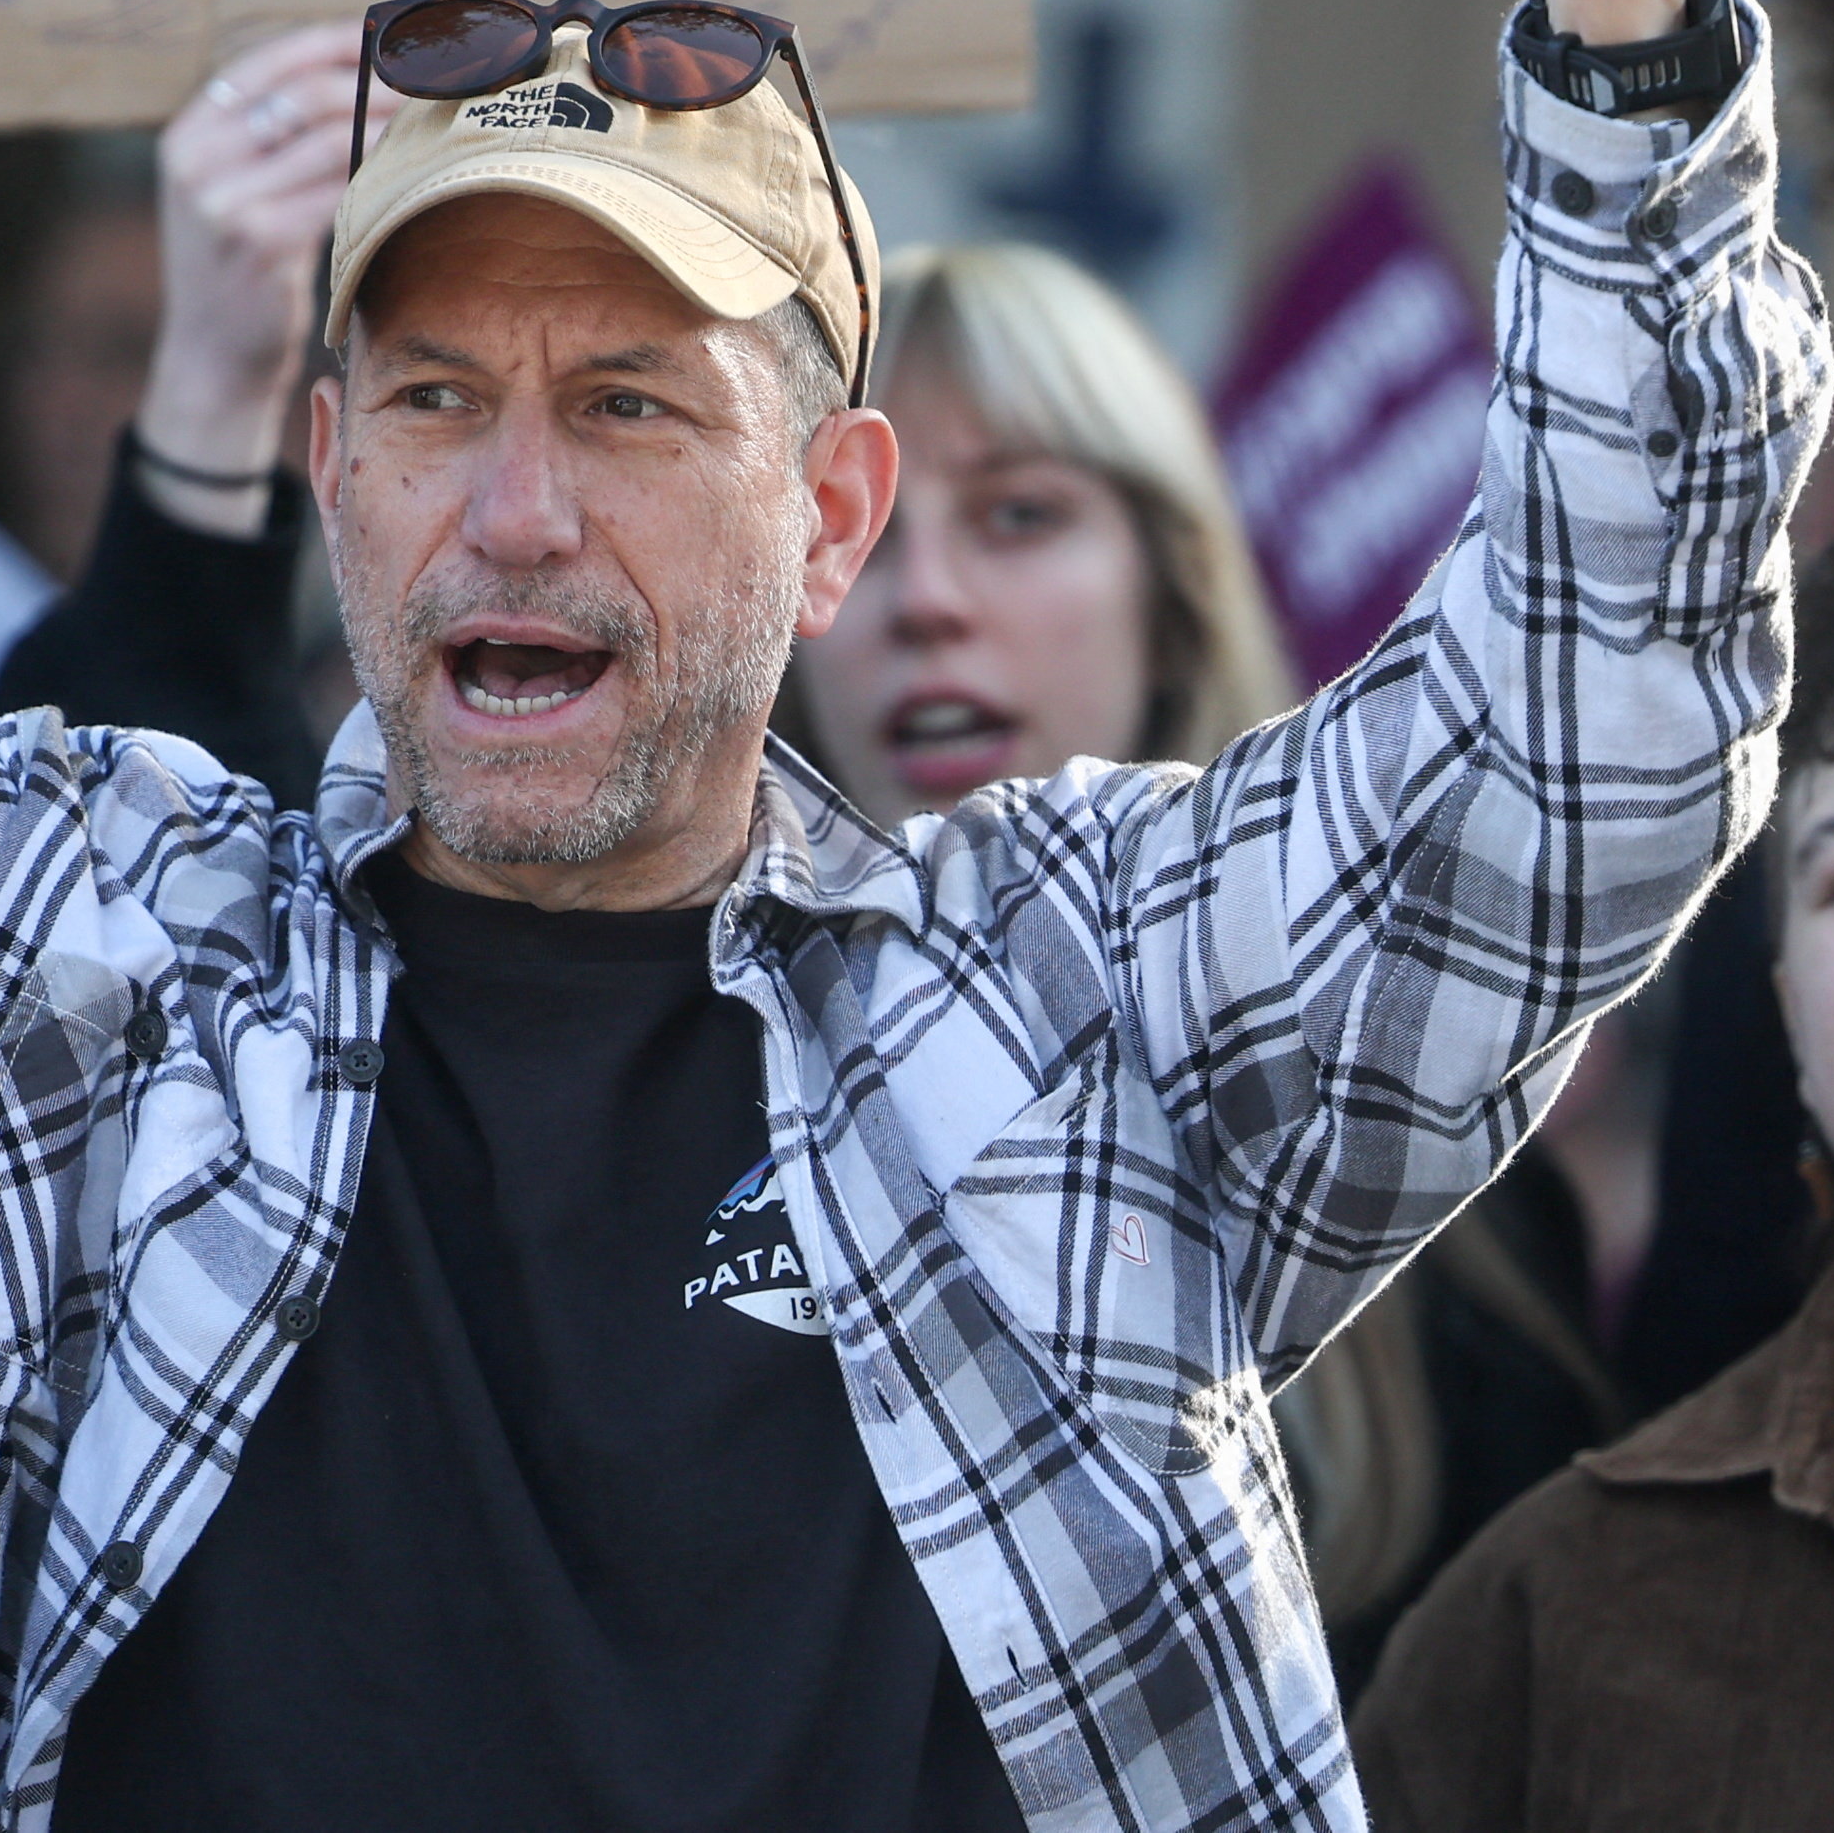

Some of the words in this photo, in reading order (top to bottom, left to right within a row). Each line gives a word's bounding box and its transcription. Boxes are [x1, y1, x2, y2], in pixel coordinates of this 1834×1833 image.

[505, 83, 555, 102] THE
[465, 101, 552, 118] NORTH
[480, 115, 545, 129] FACE
[790, 1296, 826, 1321] 19
